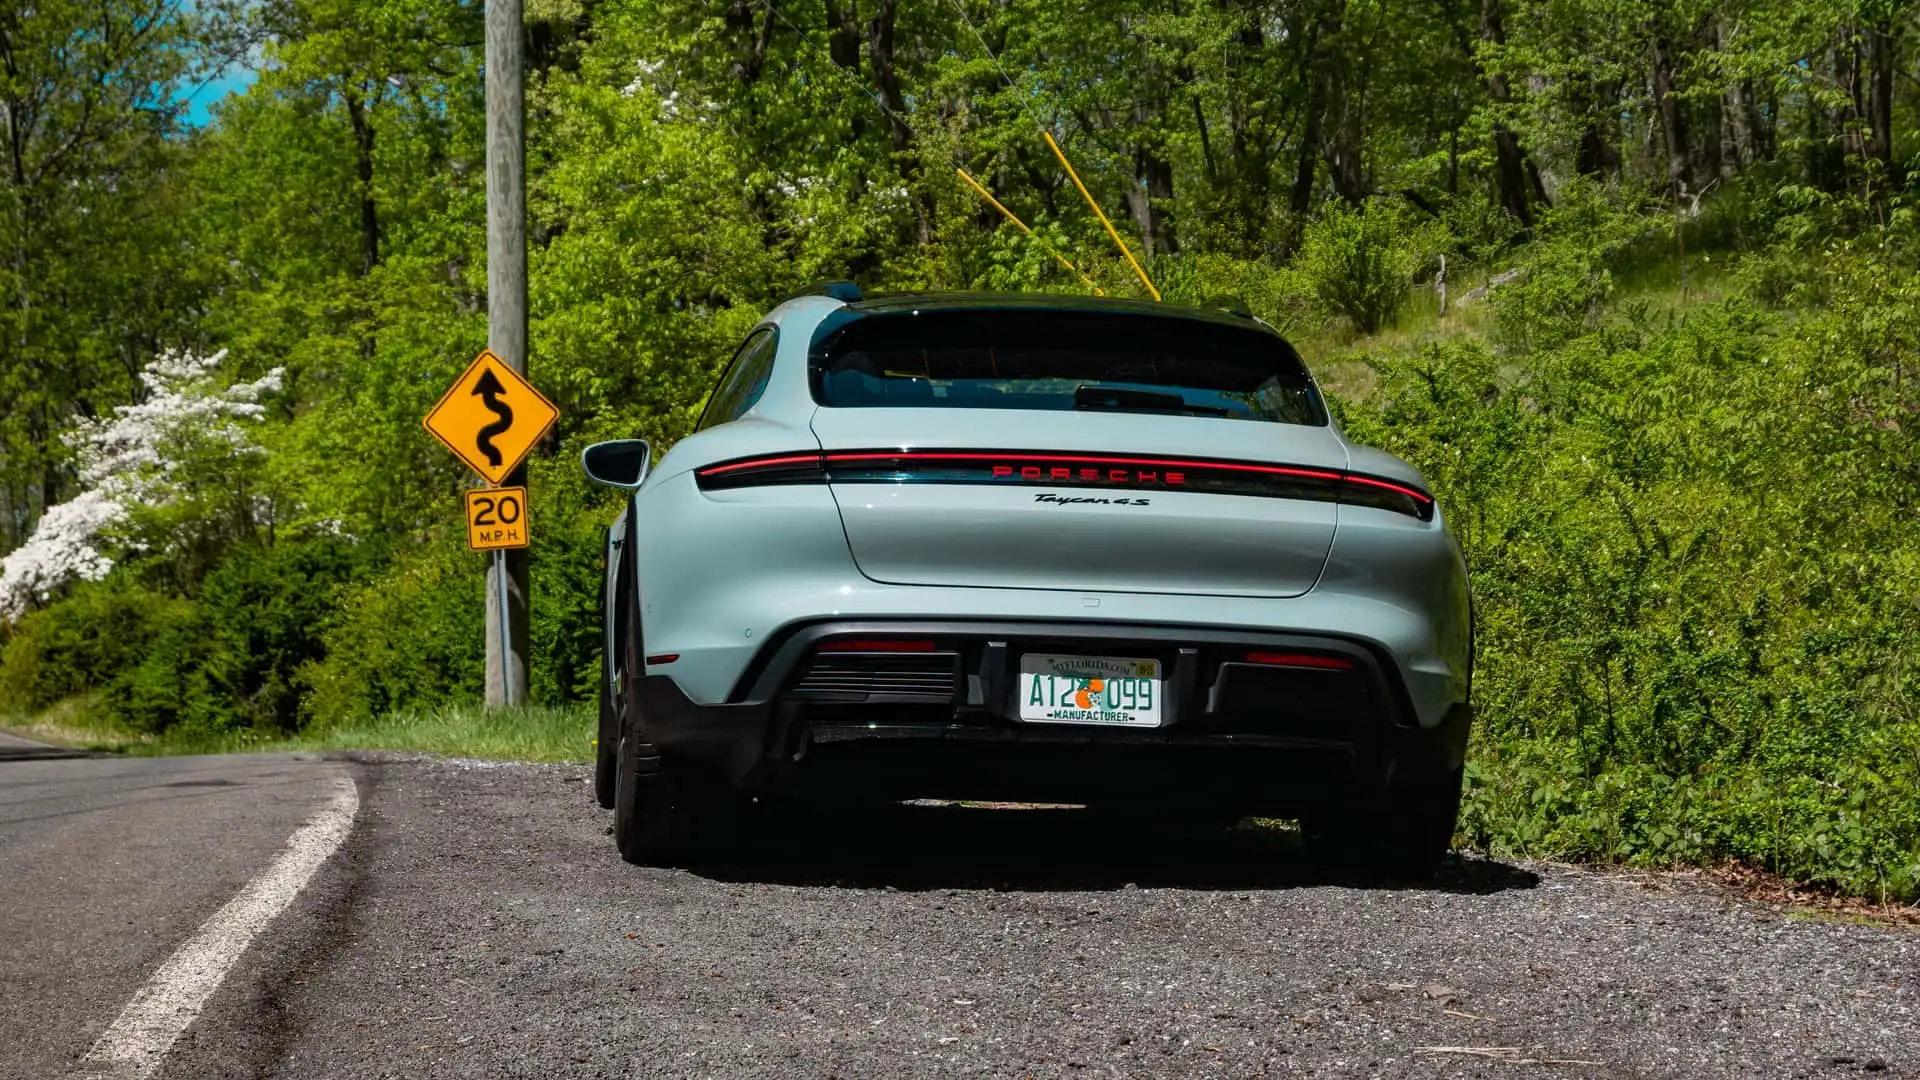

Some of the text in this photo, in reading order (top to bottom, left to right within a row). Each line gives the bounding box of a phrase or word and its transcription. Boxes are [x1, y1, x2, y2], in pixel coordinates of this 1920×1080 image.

[992, 466, 1185, 484] PORSCHE
[1034, 493, 1151, 506] Taycan 4S
[473, 496, 520, 527] 20
[1053, 709, 1129, 722] MANUFACTURER
